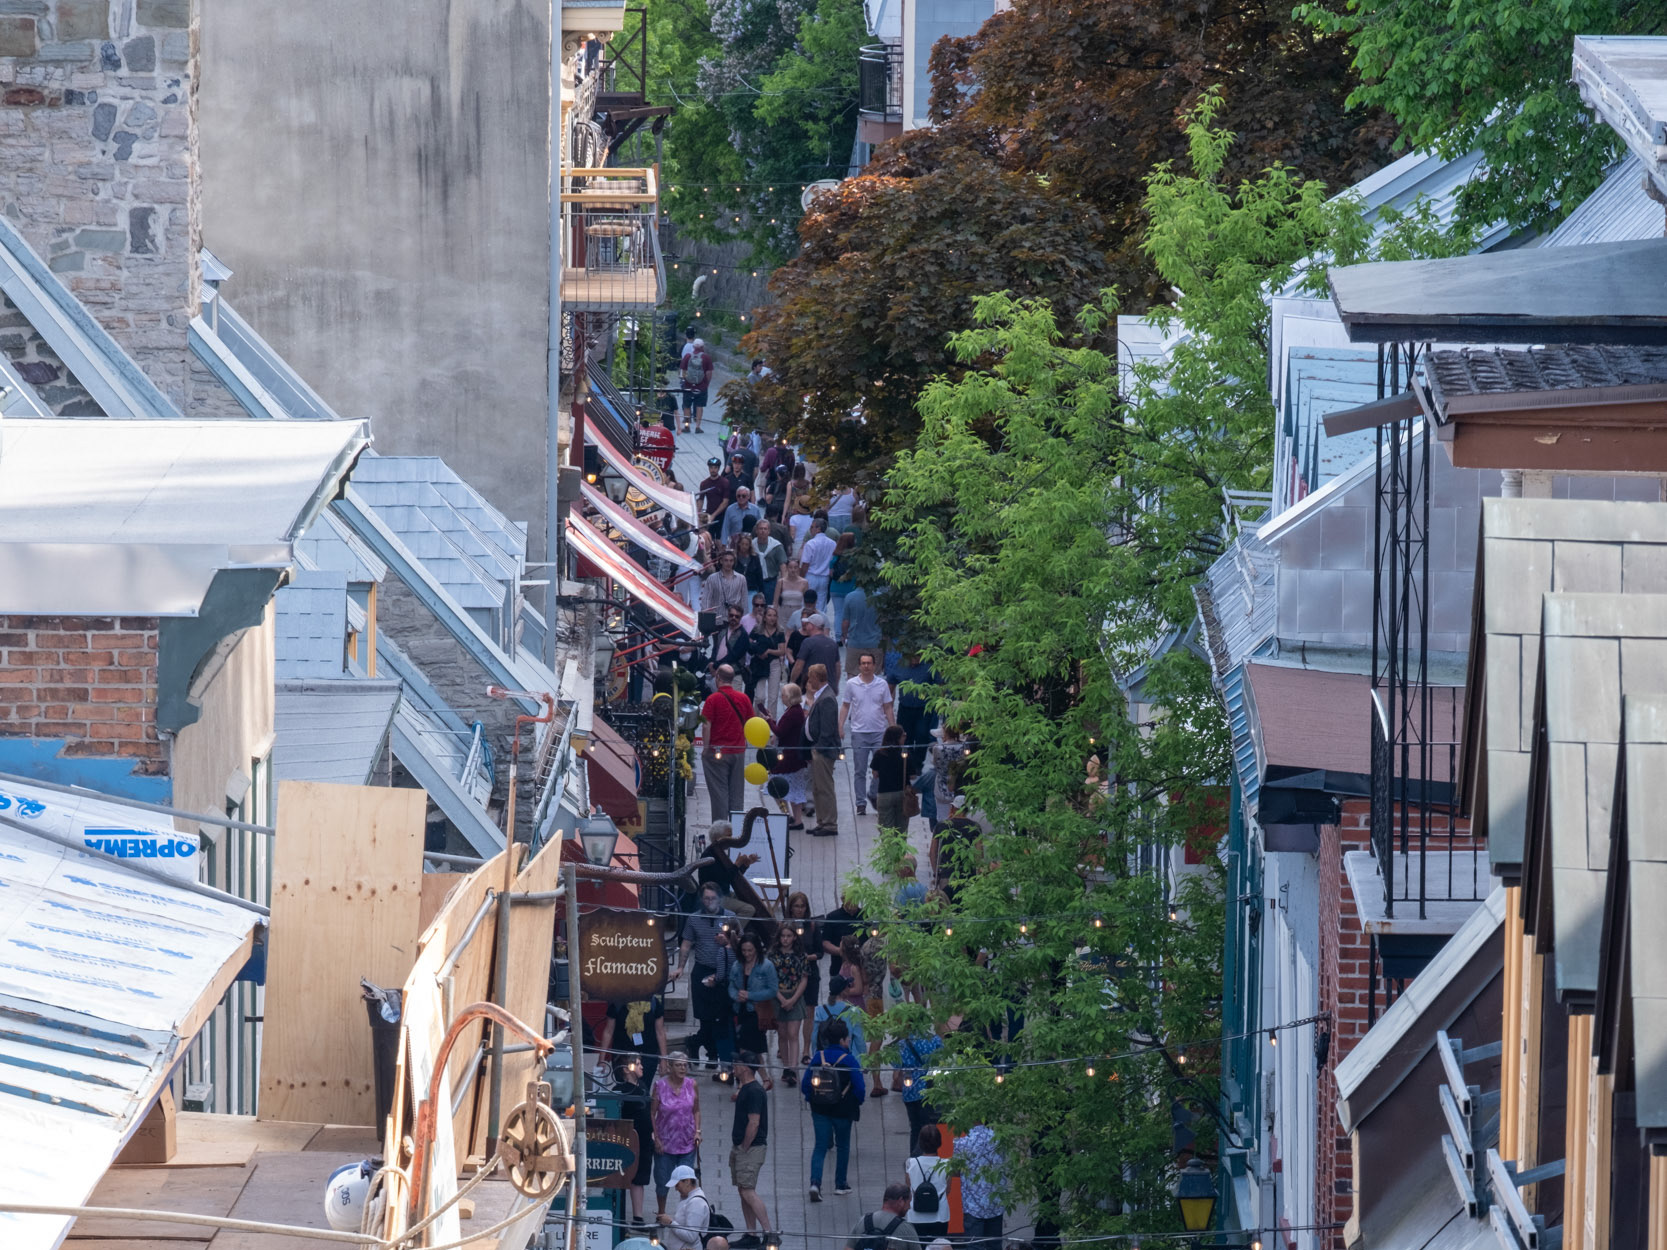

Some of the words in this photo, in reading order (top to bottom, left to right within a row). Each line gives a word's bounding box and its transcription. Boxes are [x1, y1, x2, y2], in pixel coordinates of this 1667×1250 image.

[590, 932, 654, 949] Sculpteur
[584, 957, 657, 977] Flamand
[586, 1157, 625, 1176] RRIER
